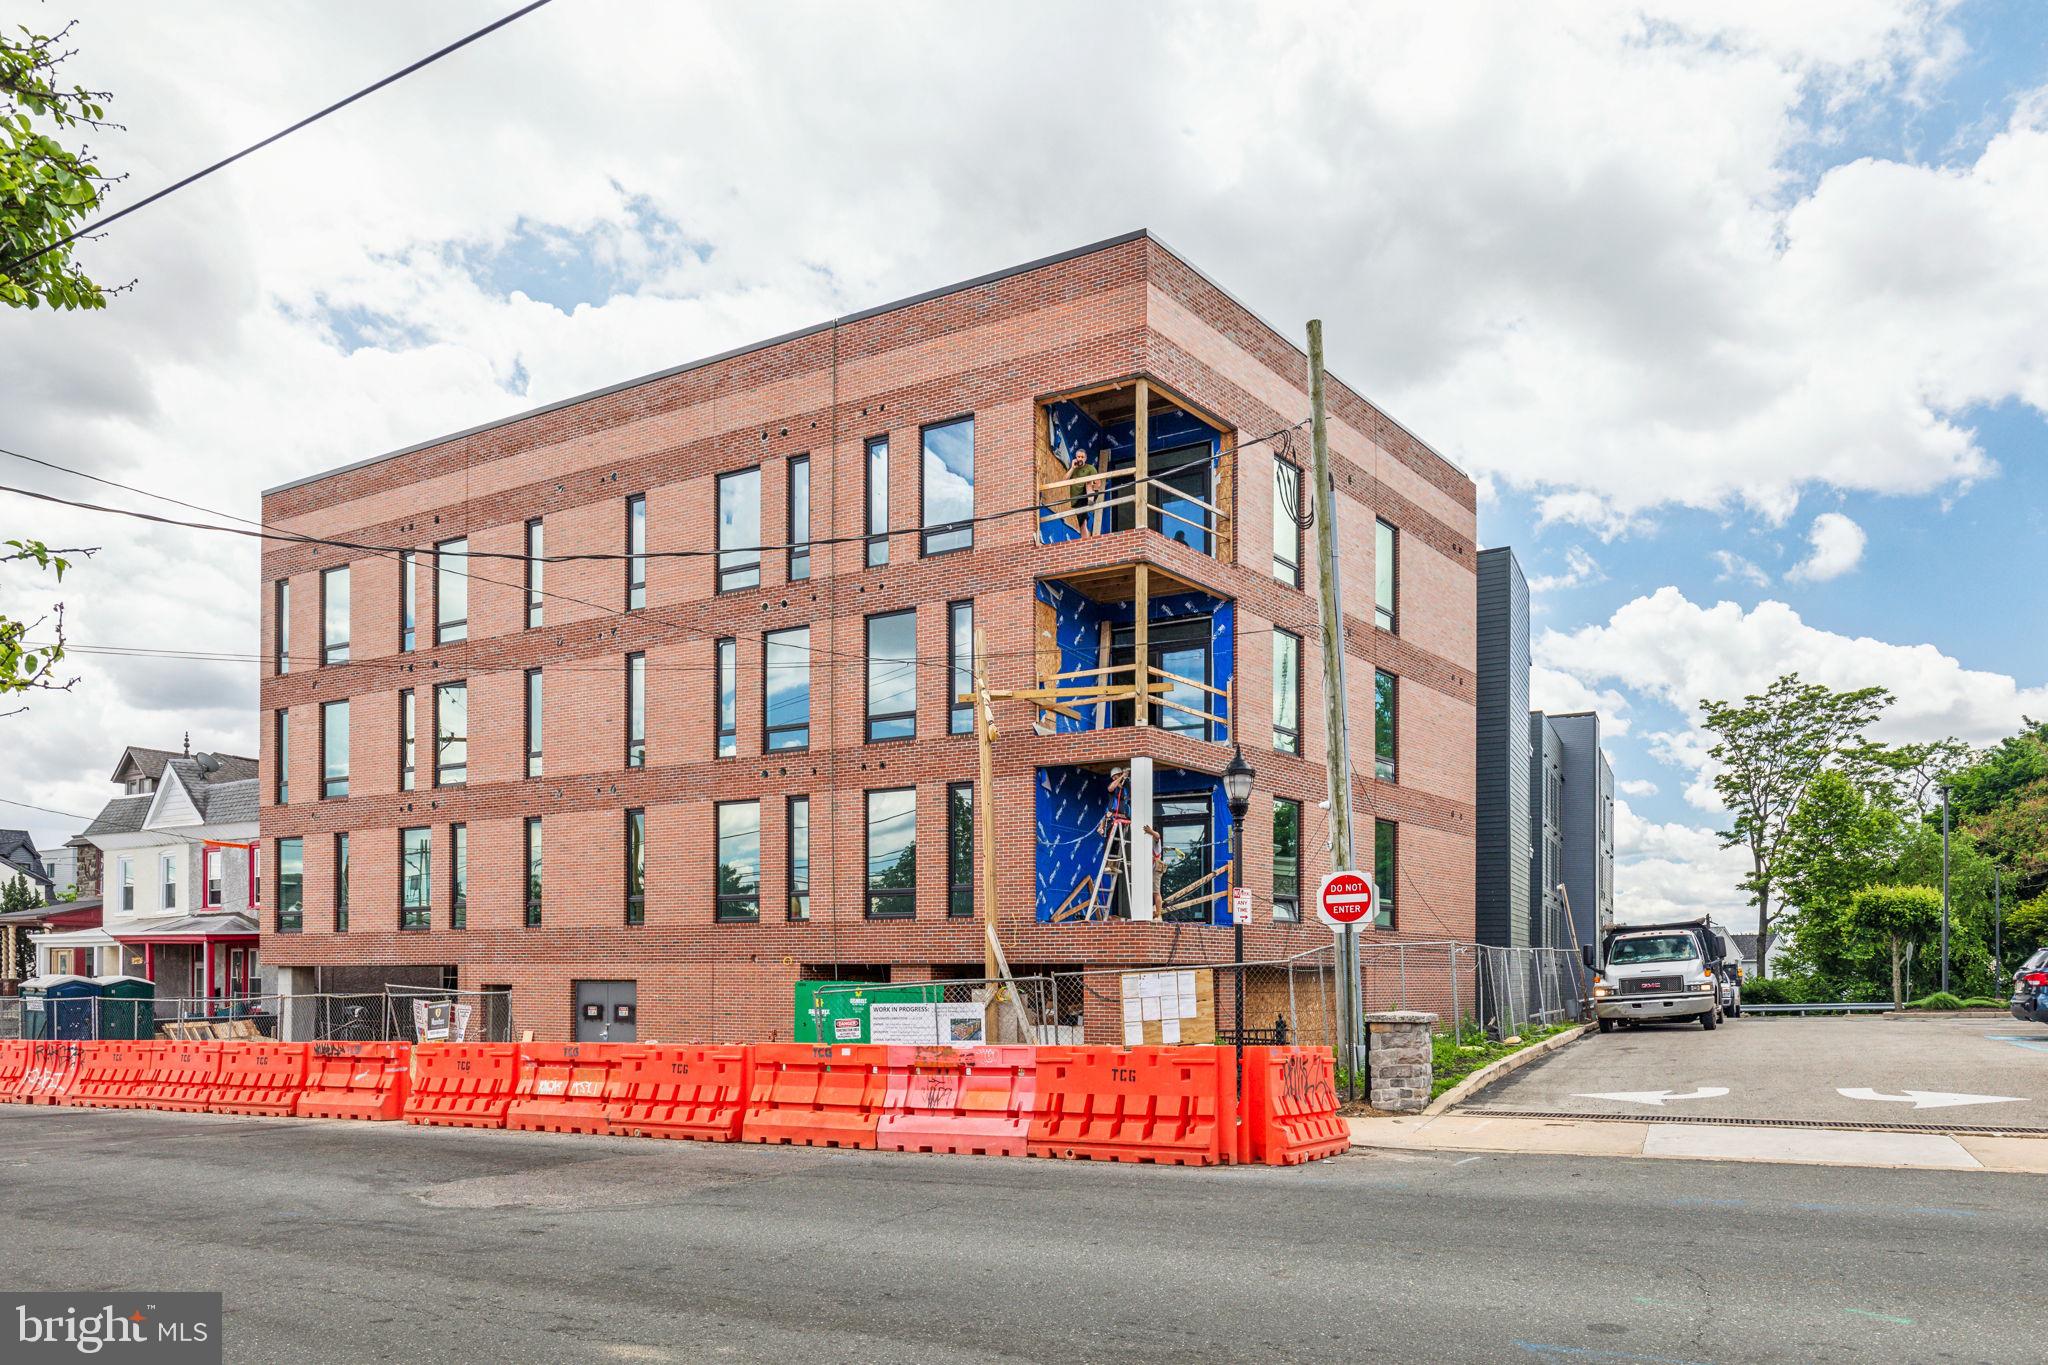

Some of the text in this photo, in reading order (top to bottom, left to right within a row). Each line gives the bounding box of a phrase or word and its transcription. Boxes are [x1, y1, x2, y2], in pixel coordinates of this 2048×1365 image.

[1331, 883, 1362, 892] DO NOT
[1333, 905, 1361, 913] ENTER
[563, 1047, 579, 1057] TCG
[813, 1047, 832, 1057] TCG
[257, 1057, 268, 1065] TCG
[457, 1061, 470, 1070] TCG
[672, 1064, 688, 1074] TCG
[1112, 1069, 1136, 1081] TCG
